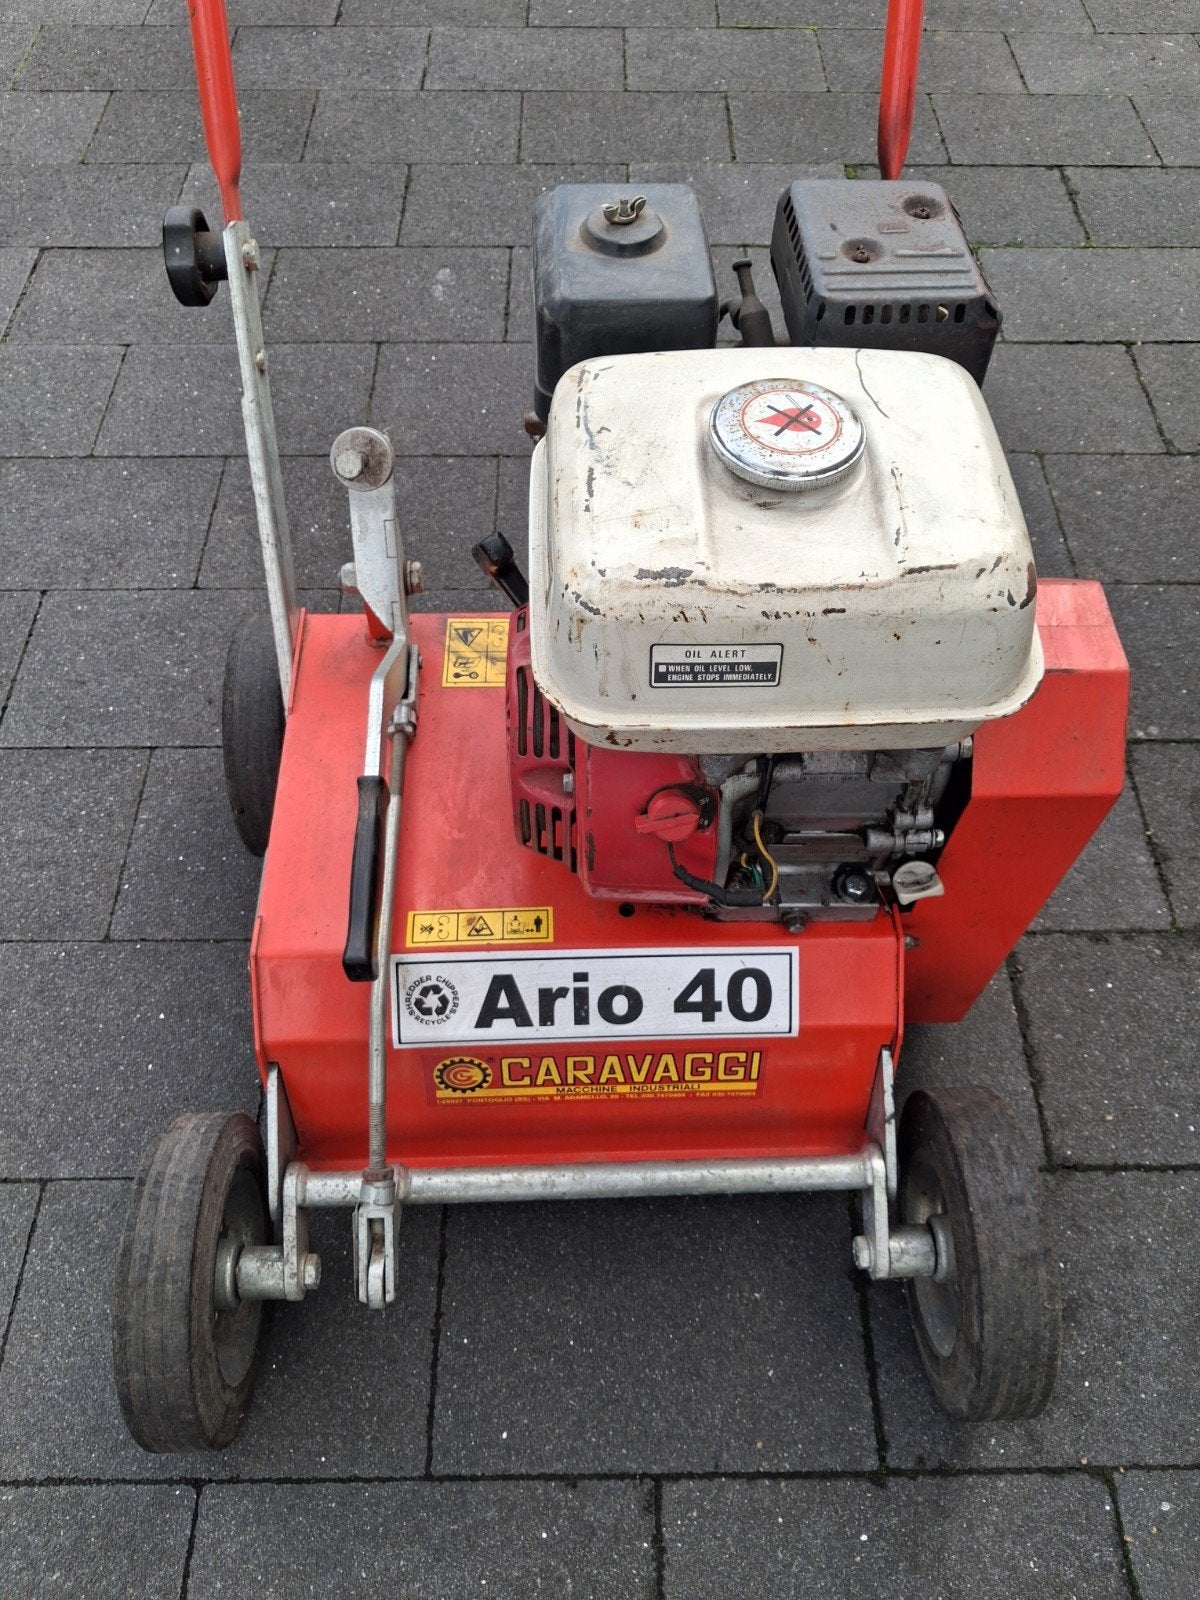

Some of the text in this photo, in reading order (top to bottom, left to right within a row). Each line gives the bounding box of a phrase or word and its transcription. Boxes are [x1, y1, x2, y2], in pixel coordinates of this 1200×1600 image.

[685, 649, 746, 658] OIL ALERT
[694, 664, 705, 672] OIL
[709, 664, 731, 672] LEVEL
[697, 673, 720, 681] STOPS
[405, 974, 460, 1016] SHREDDER CHIPPERS
[474, 967, 773, 1029] Ario 40
[414, 1014, 452, 1026] RECYCLE
[500, 1051, 761, 1087] CARAVAGGI
[556, 1084, 701, 1094] MACCHINE INDUSTRIALI
